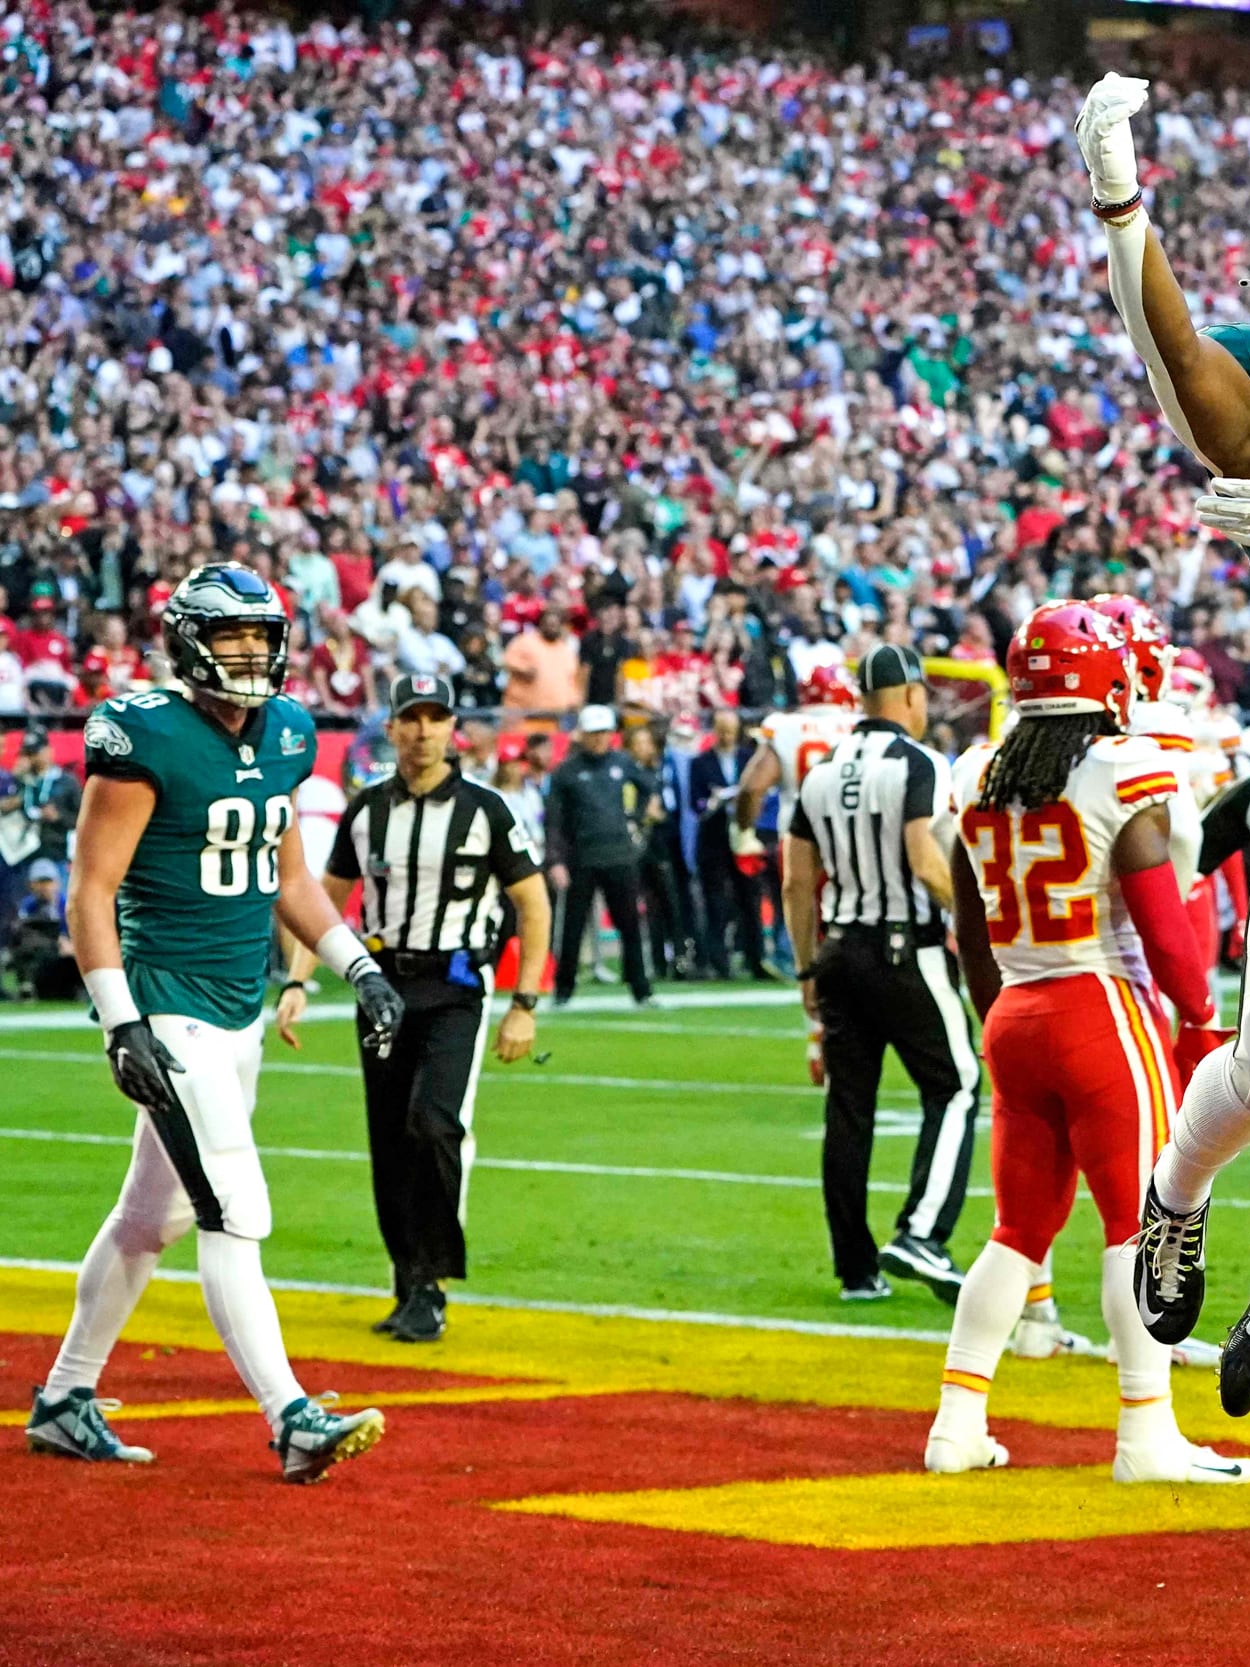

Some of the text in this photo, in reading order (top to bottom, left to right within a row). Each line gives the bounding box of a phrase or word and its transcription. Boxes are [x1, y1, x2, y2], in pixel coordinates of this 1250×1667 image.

[200, 795, 294, 898] 88
[841, 780, 862, 810] 6
[961, 796, 1100, 947] 32
